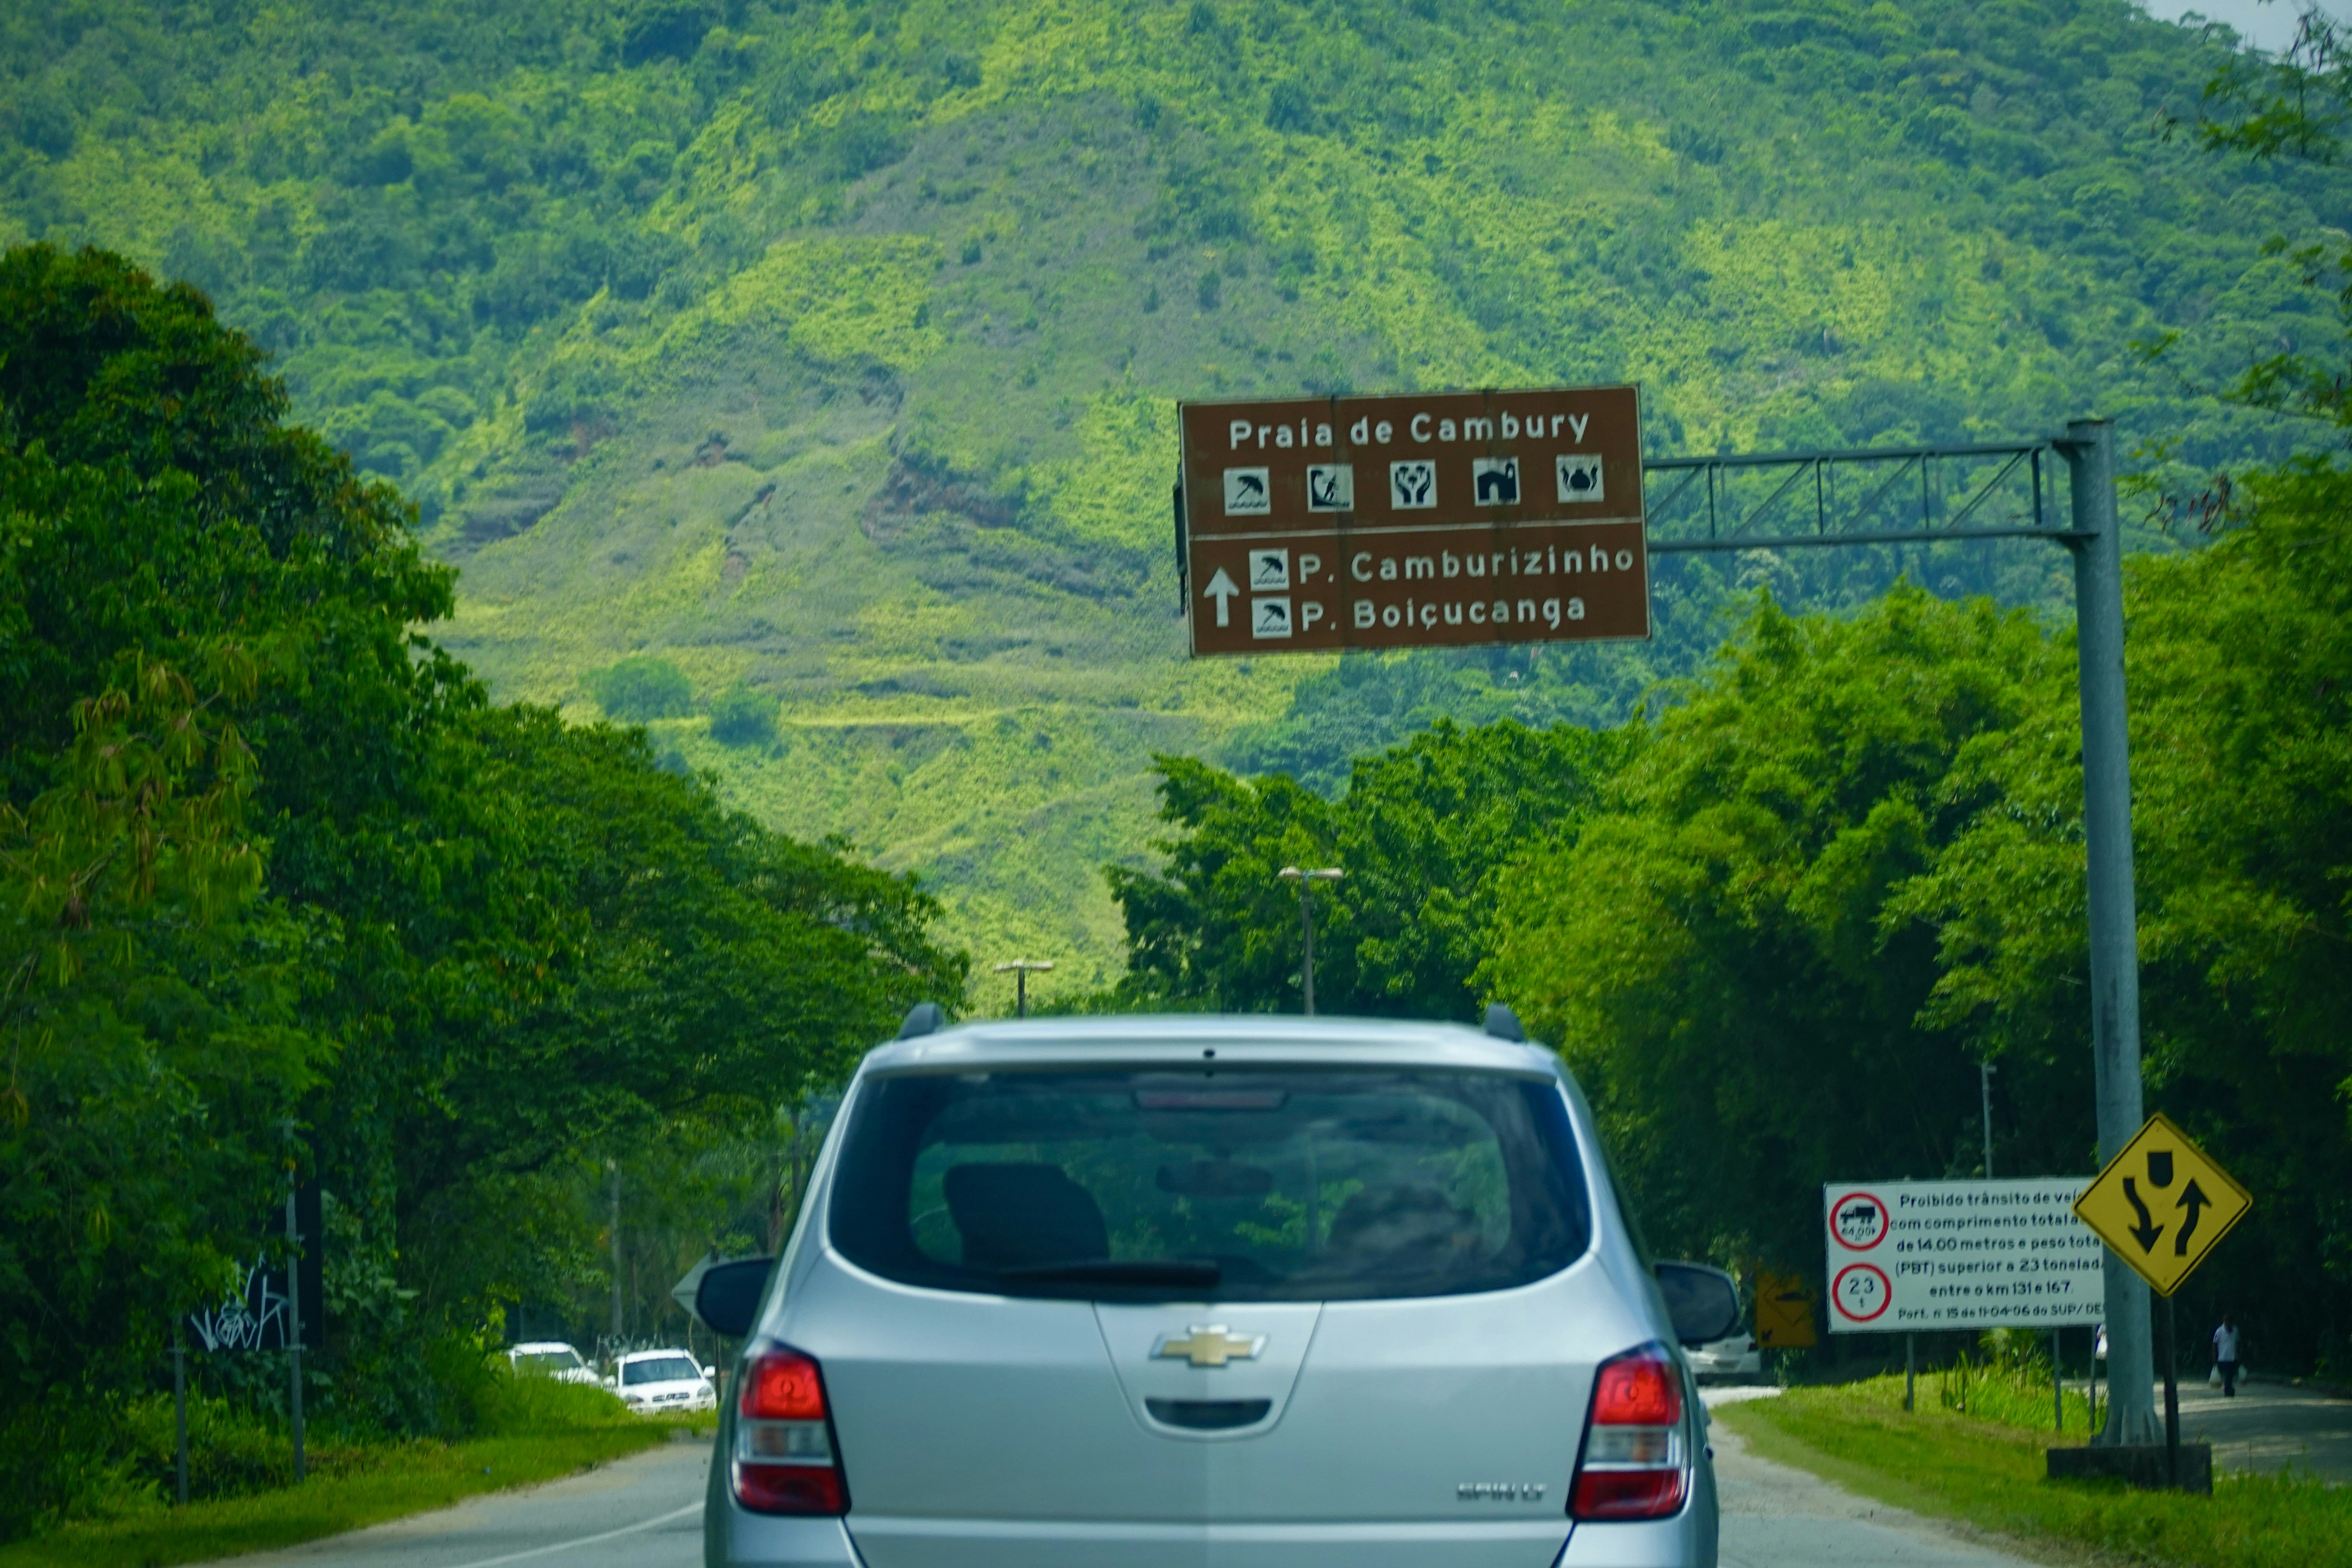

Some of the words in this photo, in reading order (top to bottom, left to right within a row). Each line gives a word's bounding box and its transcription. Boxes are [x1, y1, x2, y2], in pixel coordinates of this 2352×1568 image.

[1229, 416, 1333, 450] Praia
[1350, 415, 1393, 446] de
[1410, 410, 1589, 444] Cambury
[1298, 553, 1334, 584] P.
[1351, 543, 1633, 582] Camburizinho
[1302, 600, 1336, 632] P.
[1354, 596, 1585, 631] Boiçucanga
[1900, 1192, 1963, 1207] Proibido
[1967, 1190, 2030, 1206] trânsito
[2033, 1191, 2050, 1204] de
[1890, 1218, 1921, 1231] com
[1924, 1213, 2027, 1231] comprimento
[2031, 1212, 2068, 1226] total
[1896, 1238, 1914, 1253] de
[1960, 1235, 2015, 1251] metros
[2018, 1237, 2026, 1249] e
[2031, 1236, 2066, 1252] peso
[1895, 1259, 1935, 1278] (PBT)
[1938, 1258, 2003, 1276] superior
[2006, 1261, 2014, 1272] a
[2019, 1257, 2040, 1272] 23
[2042, 1256, 2103, 1271] tonelad
[1849, 1275, 1874, 1295] 23
[1929, 1283, 1970, 1298] entre
[1975, 1284, 1983, 1297] o
[1986, 1283, 2009, 1296] km
[2012, 1280, 2032, 1295] 131
[2034, 1283, 2042, 1295] e
[1859, 1295, 1865, 1308] t
[1457, 1482, 1516, 1501] SPIN
[1522, 1482, 1547, 1501] LT
